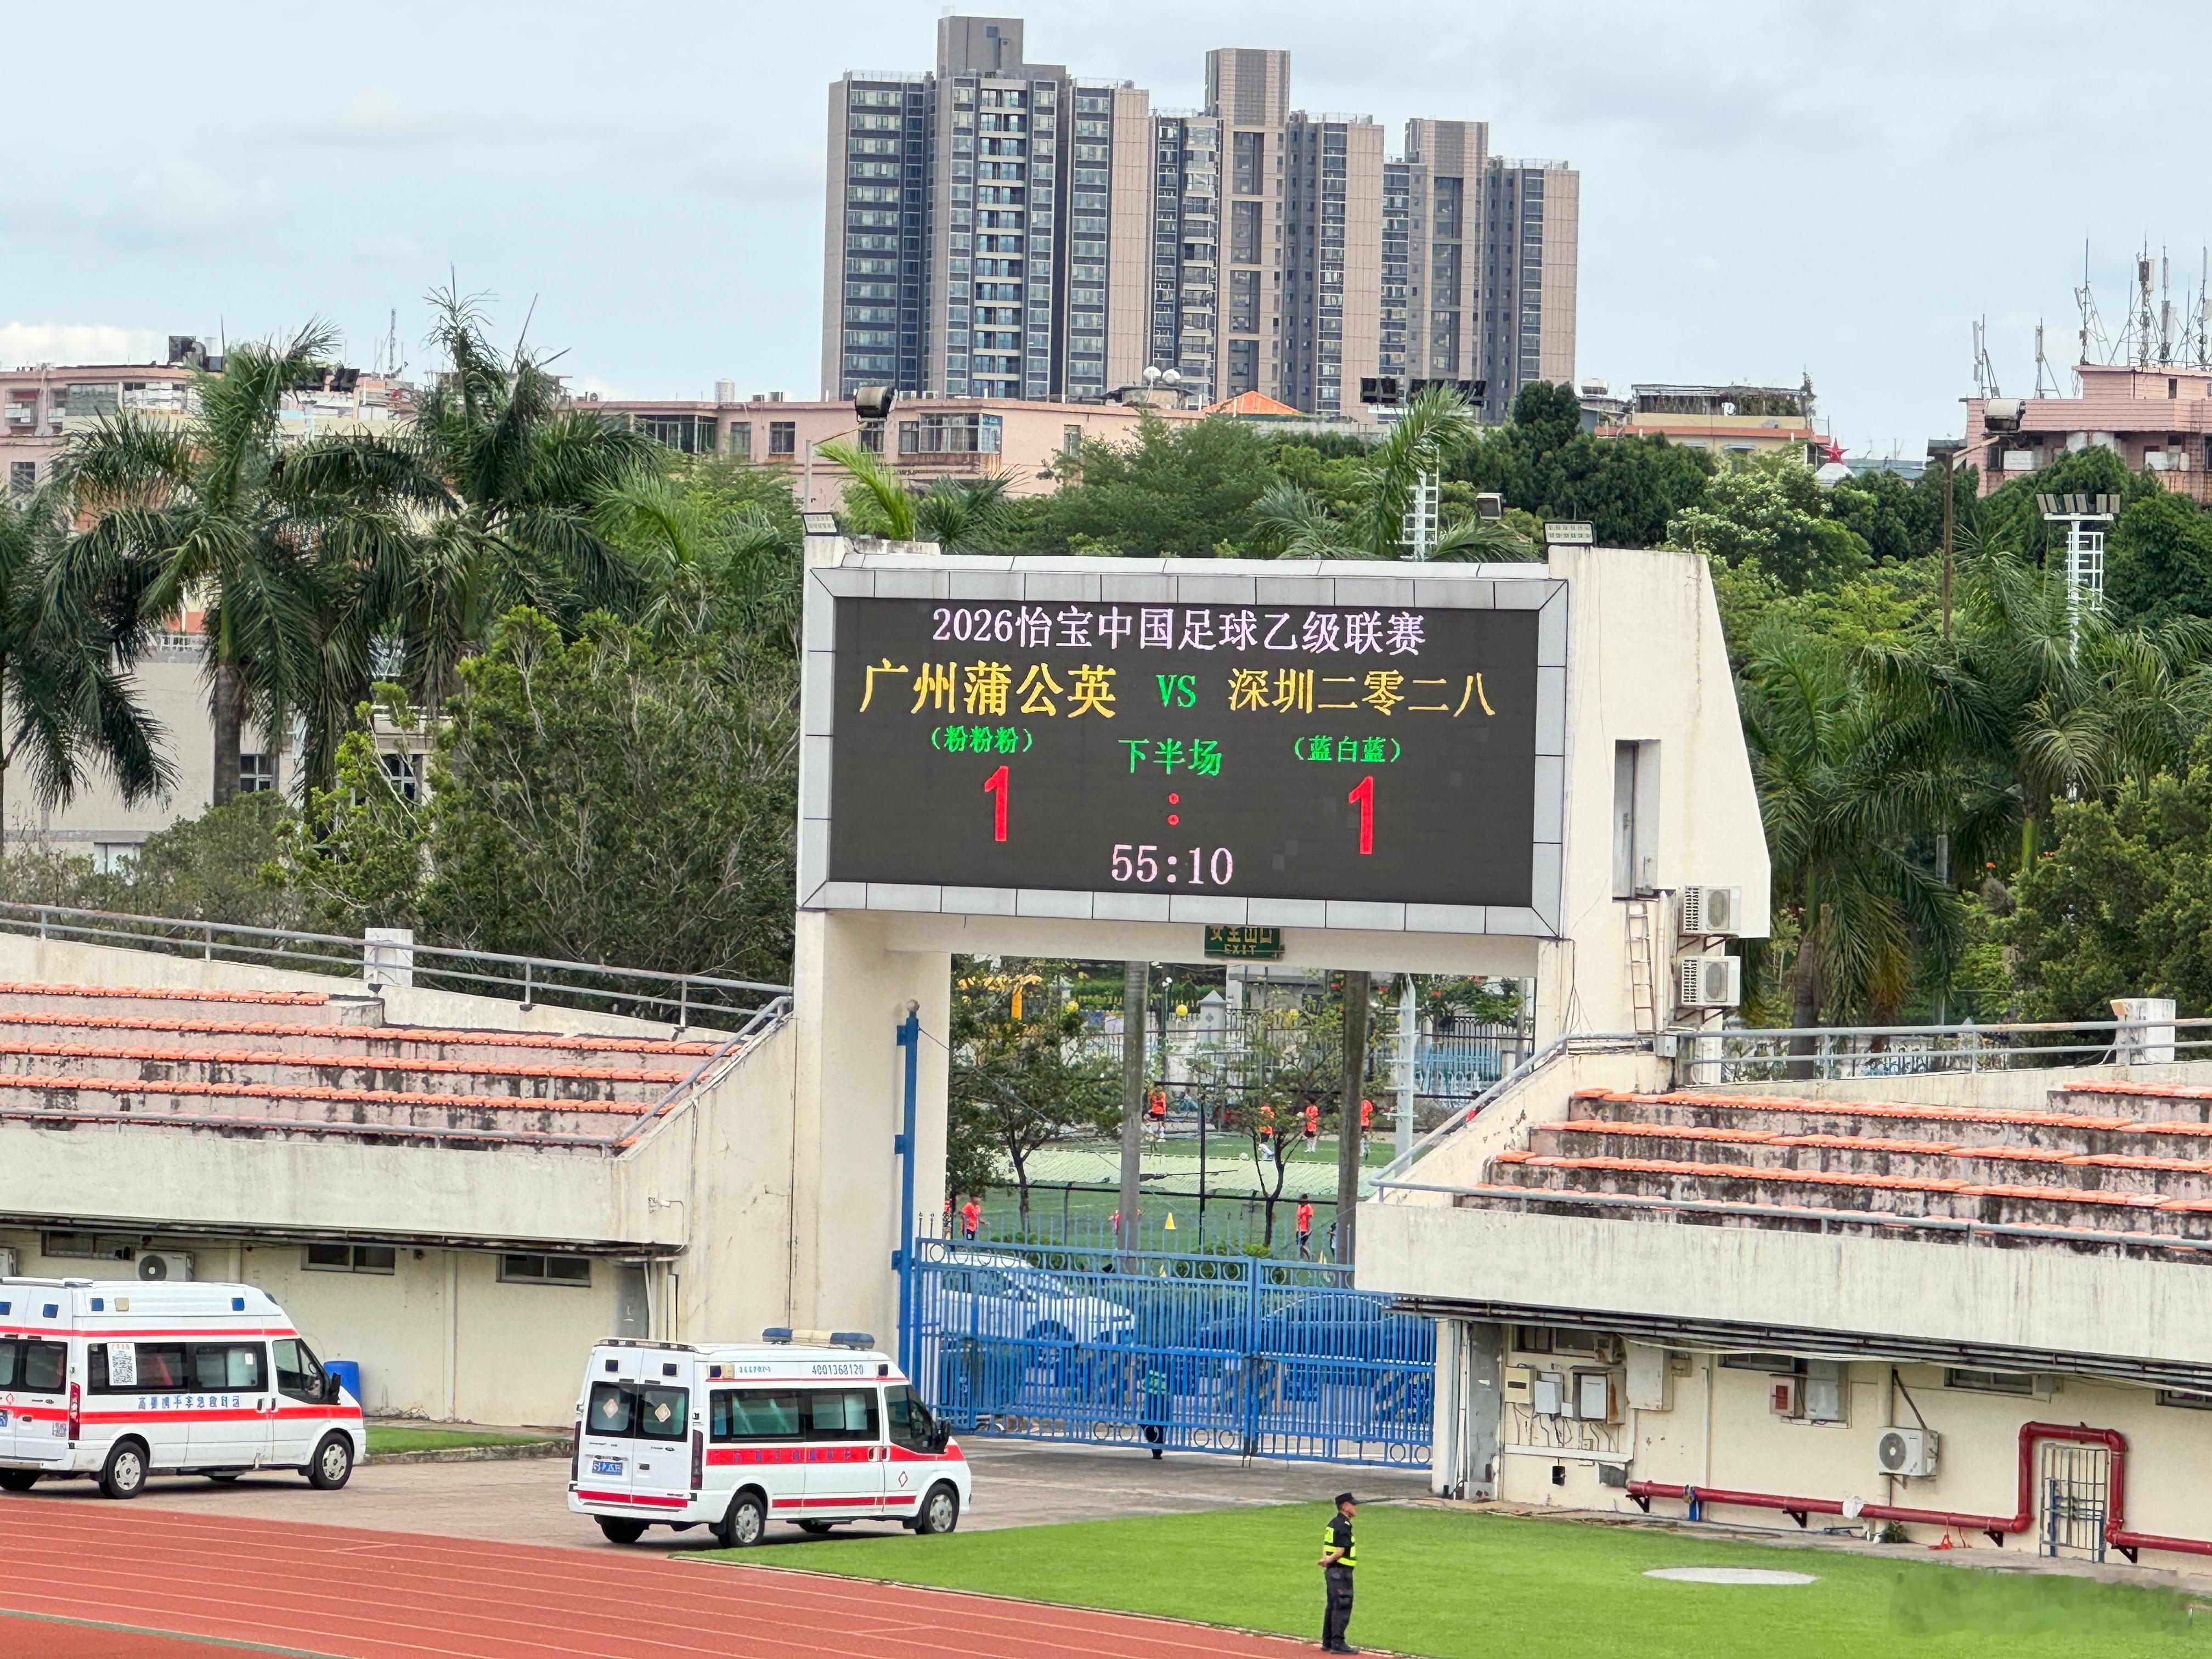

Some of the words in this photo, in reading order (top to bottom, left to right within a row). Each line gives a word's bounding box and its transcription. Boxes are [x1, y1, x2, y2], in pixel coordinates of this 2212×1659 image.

[933, 605, 1426, 656] 2026怡宝中国足球乙级联赛
[860, 659, 1117, 718] 广州蒲公英
[1156, 674, 1197, 708] VS
[1228, 668, 1496, 718] 深圳二零二八
[1118, 738, 1222, 776] 下半场
[984, 765, 1009, 842] 1
[1348, 775, 1374, 855] 1
[1111, 844, 1233, 885] 55:10
[1224, 944, 1256, 955] EXIT
